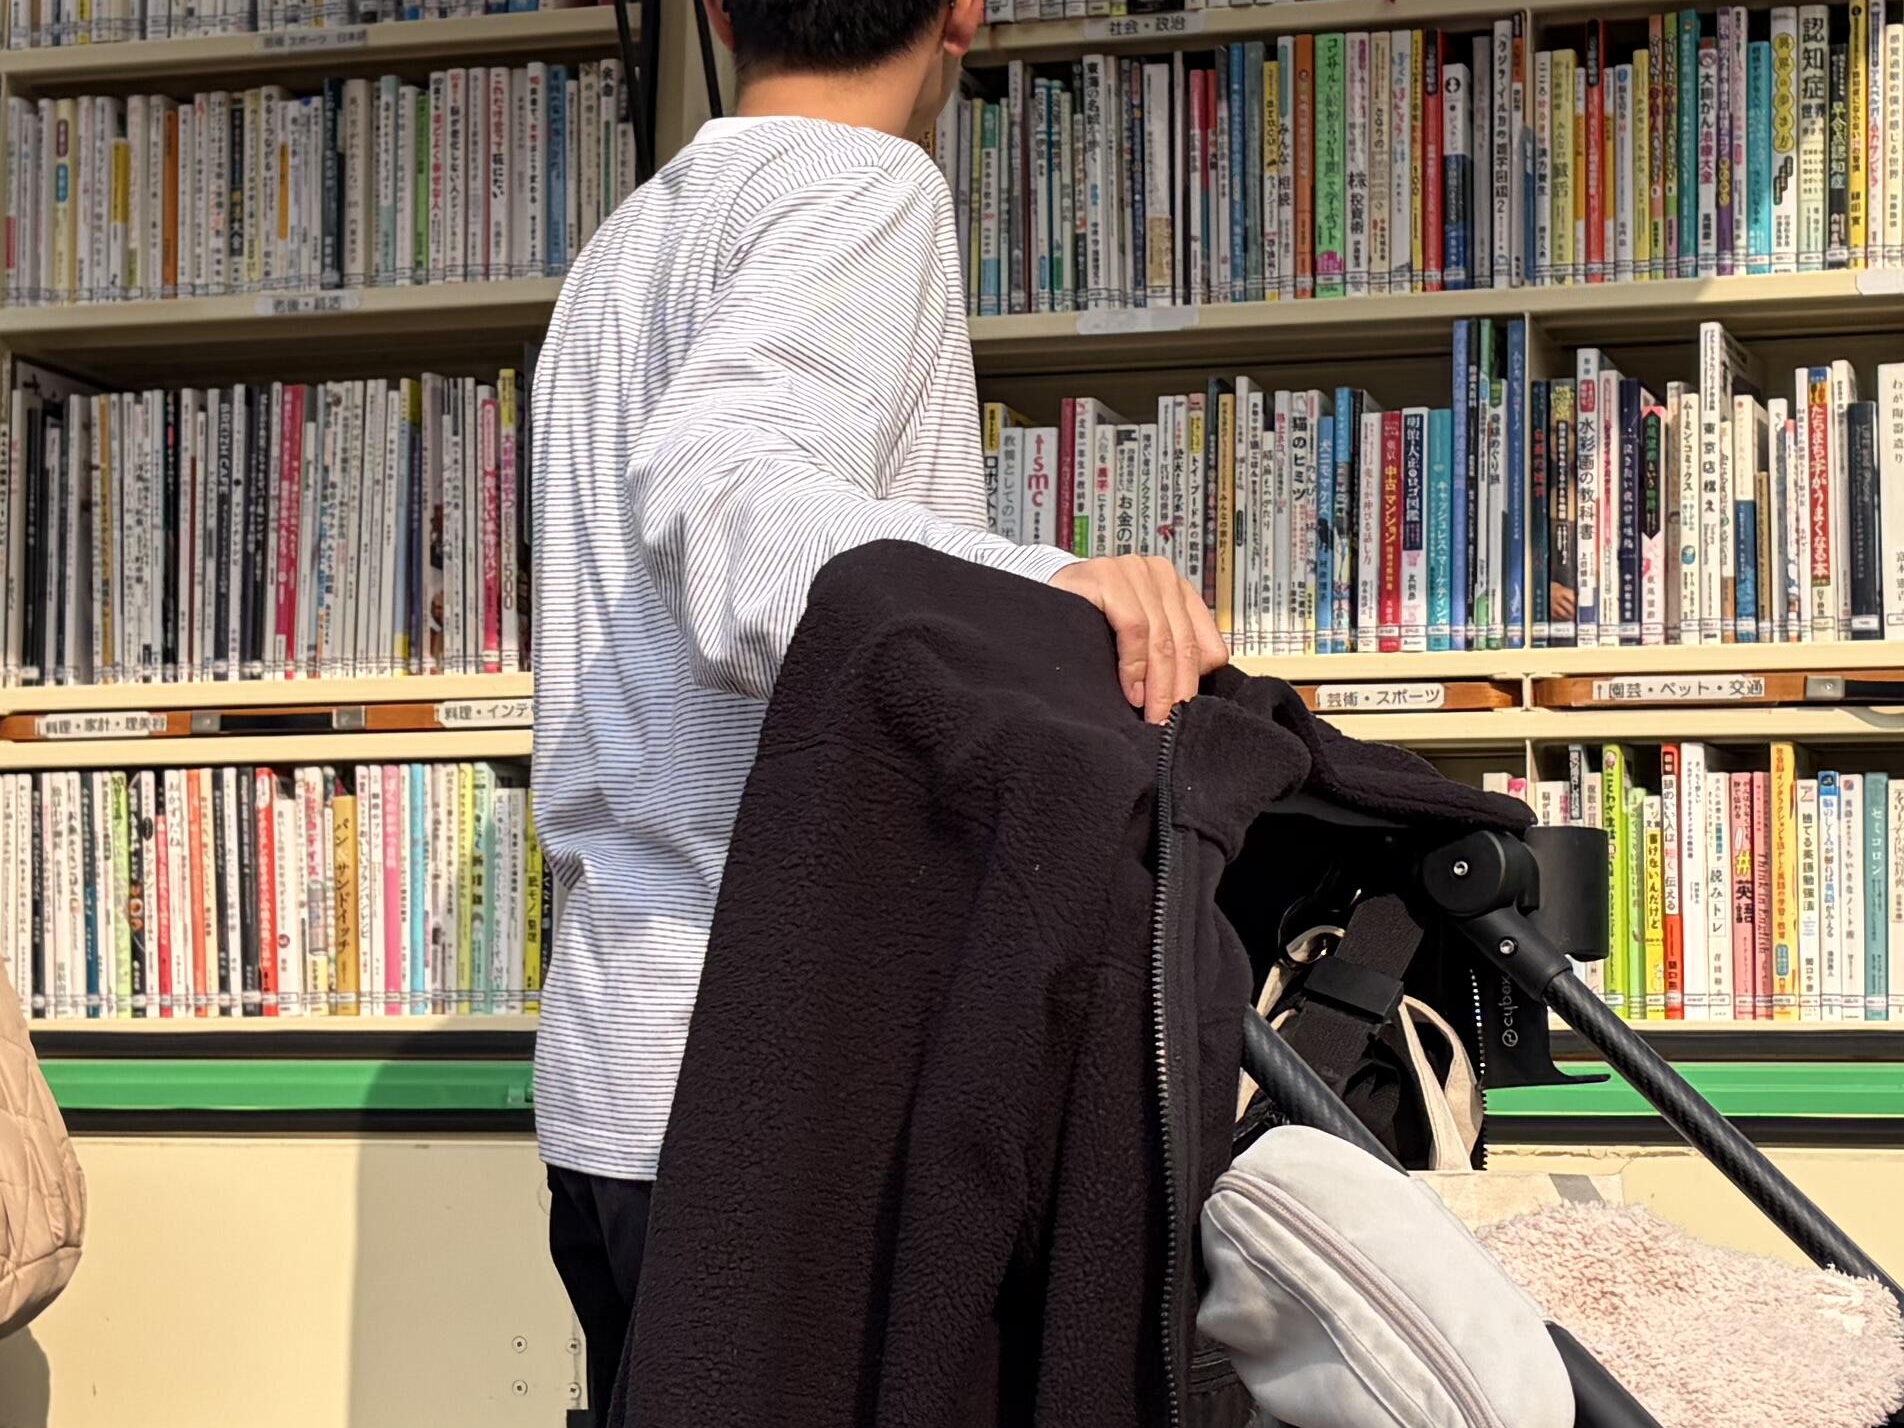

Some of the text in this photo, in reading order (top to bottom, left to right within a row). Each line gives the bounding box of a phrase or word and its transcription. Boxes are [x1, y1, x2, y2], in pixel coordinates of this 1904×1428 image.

[1109, 16, 1186, 36] 社会・政治
[1801, 16, 1825, 100] 認知症
[1292, 417, 1307, 502] 猫のヒミツ
[1683, 401, 1693, 492] ムーミンコミックス
[1892, 378, 1904, 465] わが陶器造り
[1578, 417, 1595, 541] 水彩画の教科書
[1326, 688, 1441, 708] 芸術・スポーツ
[1607, 680, 1765, 699] 園芸・ペット・交通
[1871, 809, 1883, 875] セミコロン
